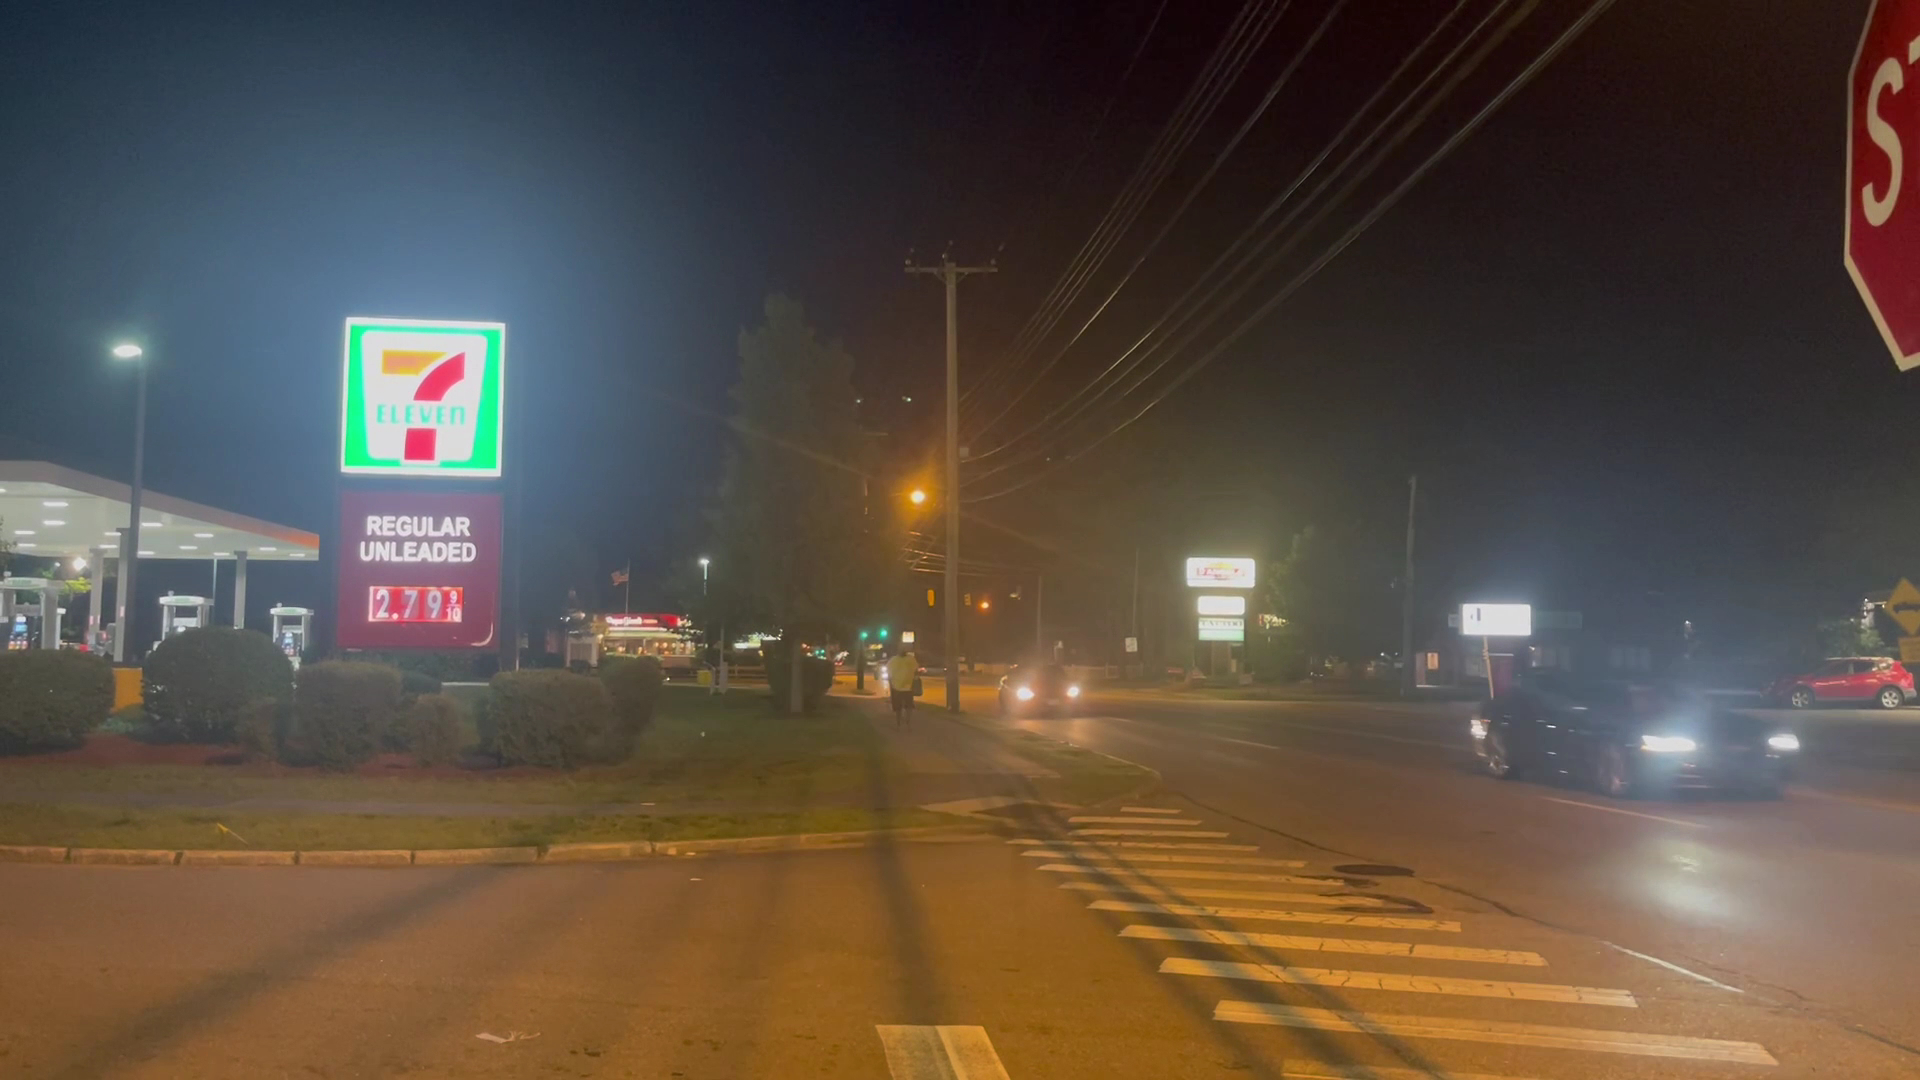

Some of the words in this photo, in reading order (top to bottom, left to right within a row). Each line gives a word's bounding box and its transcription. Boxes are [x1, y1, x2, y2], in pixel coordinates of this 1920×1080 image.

[1862, 35, 1920, 227] S
[381, 349, 465, 461] 7
[366, 515, 471, 537] REGULAR
[360, 541, 477, 563] UNLEADED
[375, 589, 443, 620] 2.79
